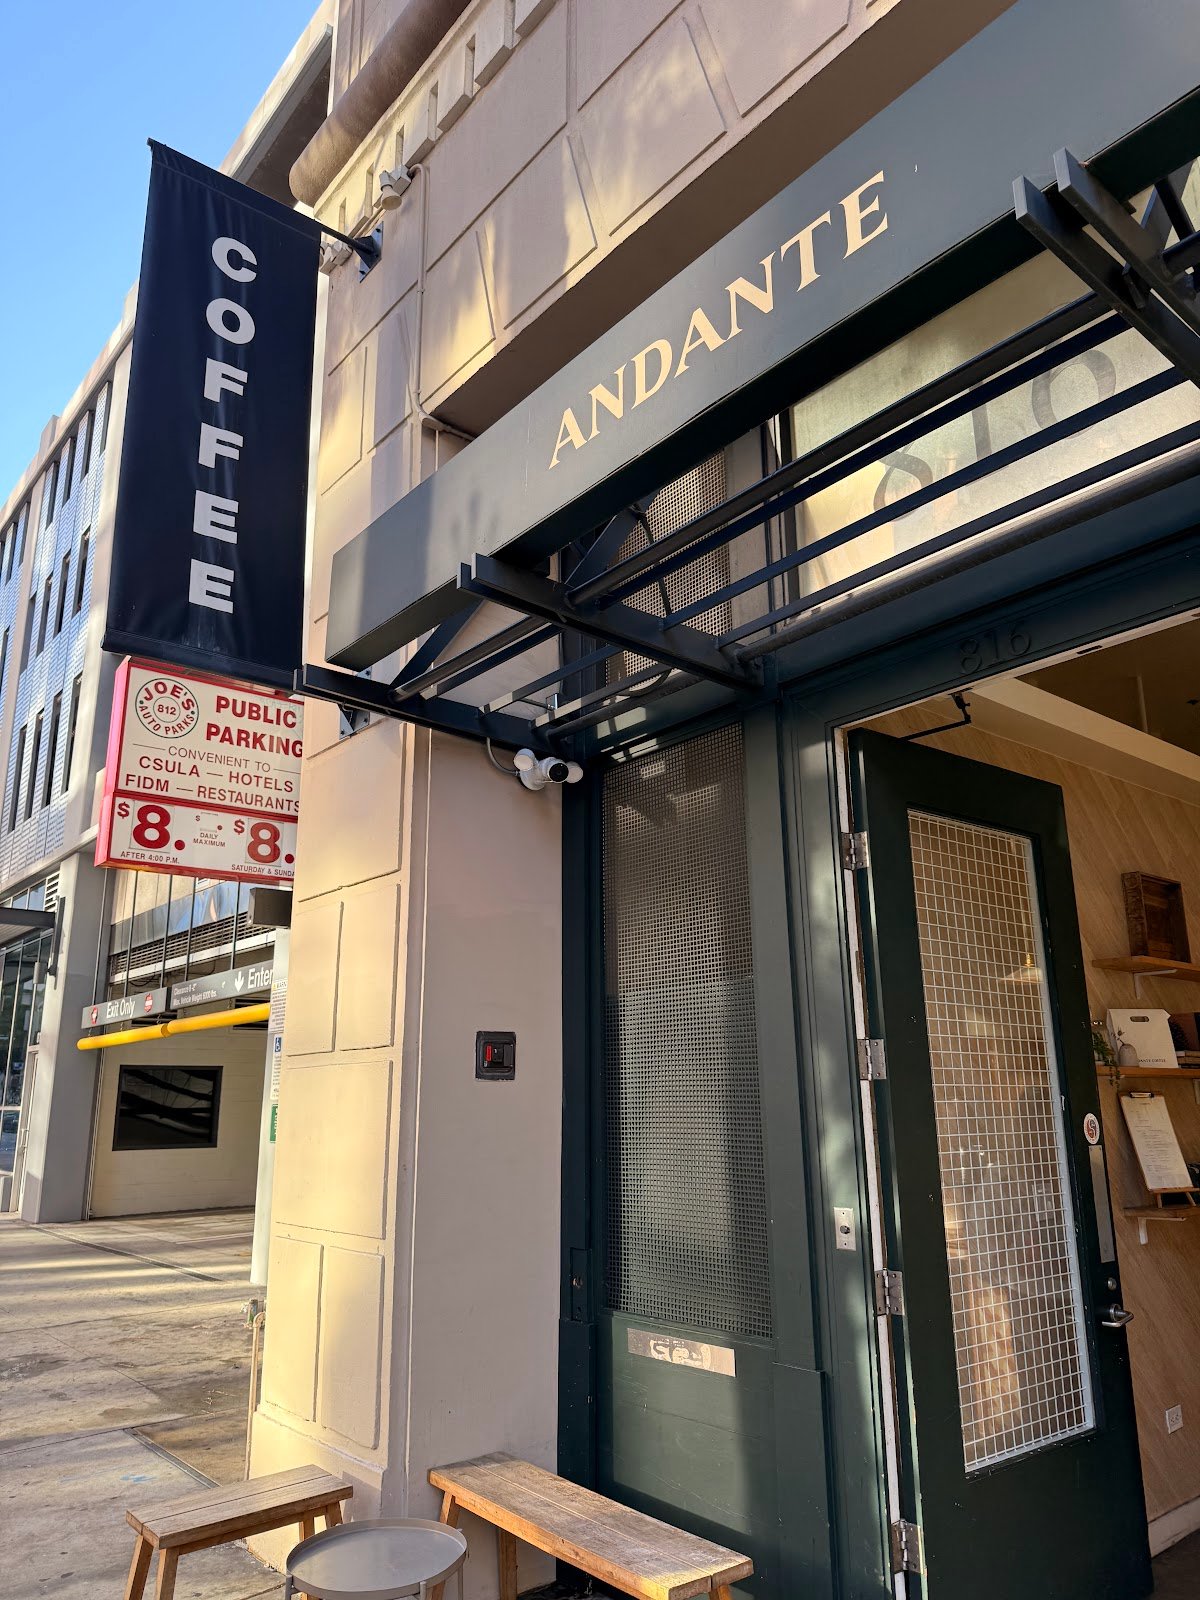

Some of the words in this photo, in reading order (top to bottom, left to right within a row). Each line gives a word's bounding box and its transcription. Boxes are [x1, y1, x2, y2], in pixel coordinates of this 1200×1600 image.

[548, 170, 888, 470] ANDANTE
[188, 236, 258, 614] COFFEE
[959, 620, 1033, 676] 816
[144, 681, 195, 711] JOE'S
[157, 704, 177, 716] 812
[139, 705, 161, 732] AUTO
[164, 714, 195, 735] PARKS
[215, 695, 297, 729] PUBLIC
[206, 722, 303, 758] PARKING
[139, 755, 201, 778] CSULA
[228, 770, 294, 793] HOTELS
[168, 745, 250, 769] CONVENIENT
[255, 760, 271, 773] TO
[125, 773, 170, 793] FIDM
[197, 785, 299, 813] RESTAURANTS
[193, 838, 226, 848] MAXIMUM
[199, 832, 219, 841] DAILY
[120, 850, 146, 860] AFTER
[148, 854, 164, 863] 4:00
[165, 857, 180, 865] P.M.
[231, 863, 266, 875] SATURDAY
[267, 867, 273, 875] &
[247, 966, 274, 990] Enter
[106, 1001, 120, 1019] Exit
[120, 998, 136, 1018] Only
